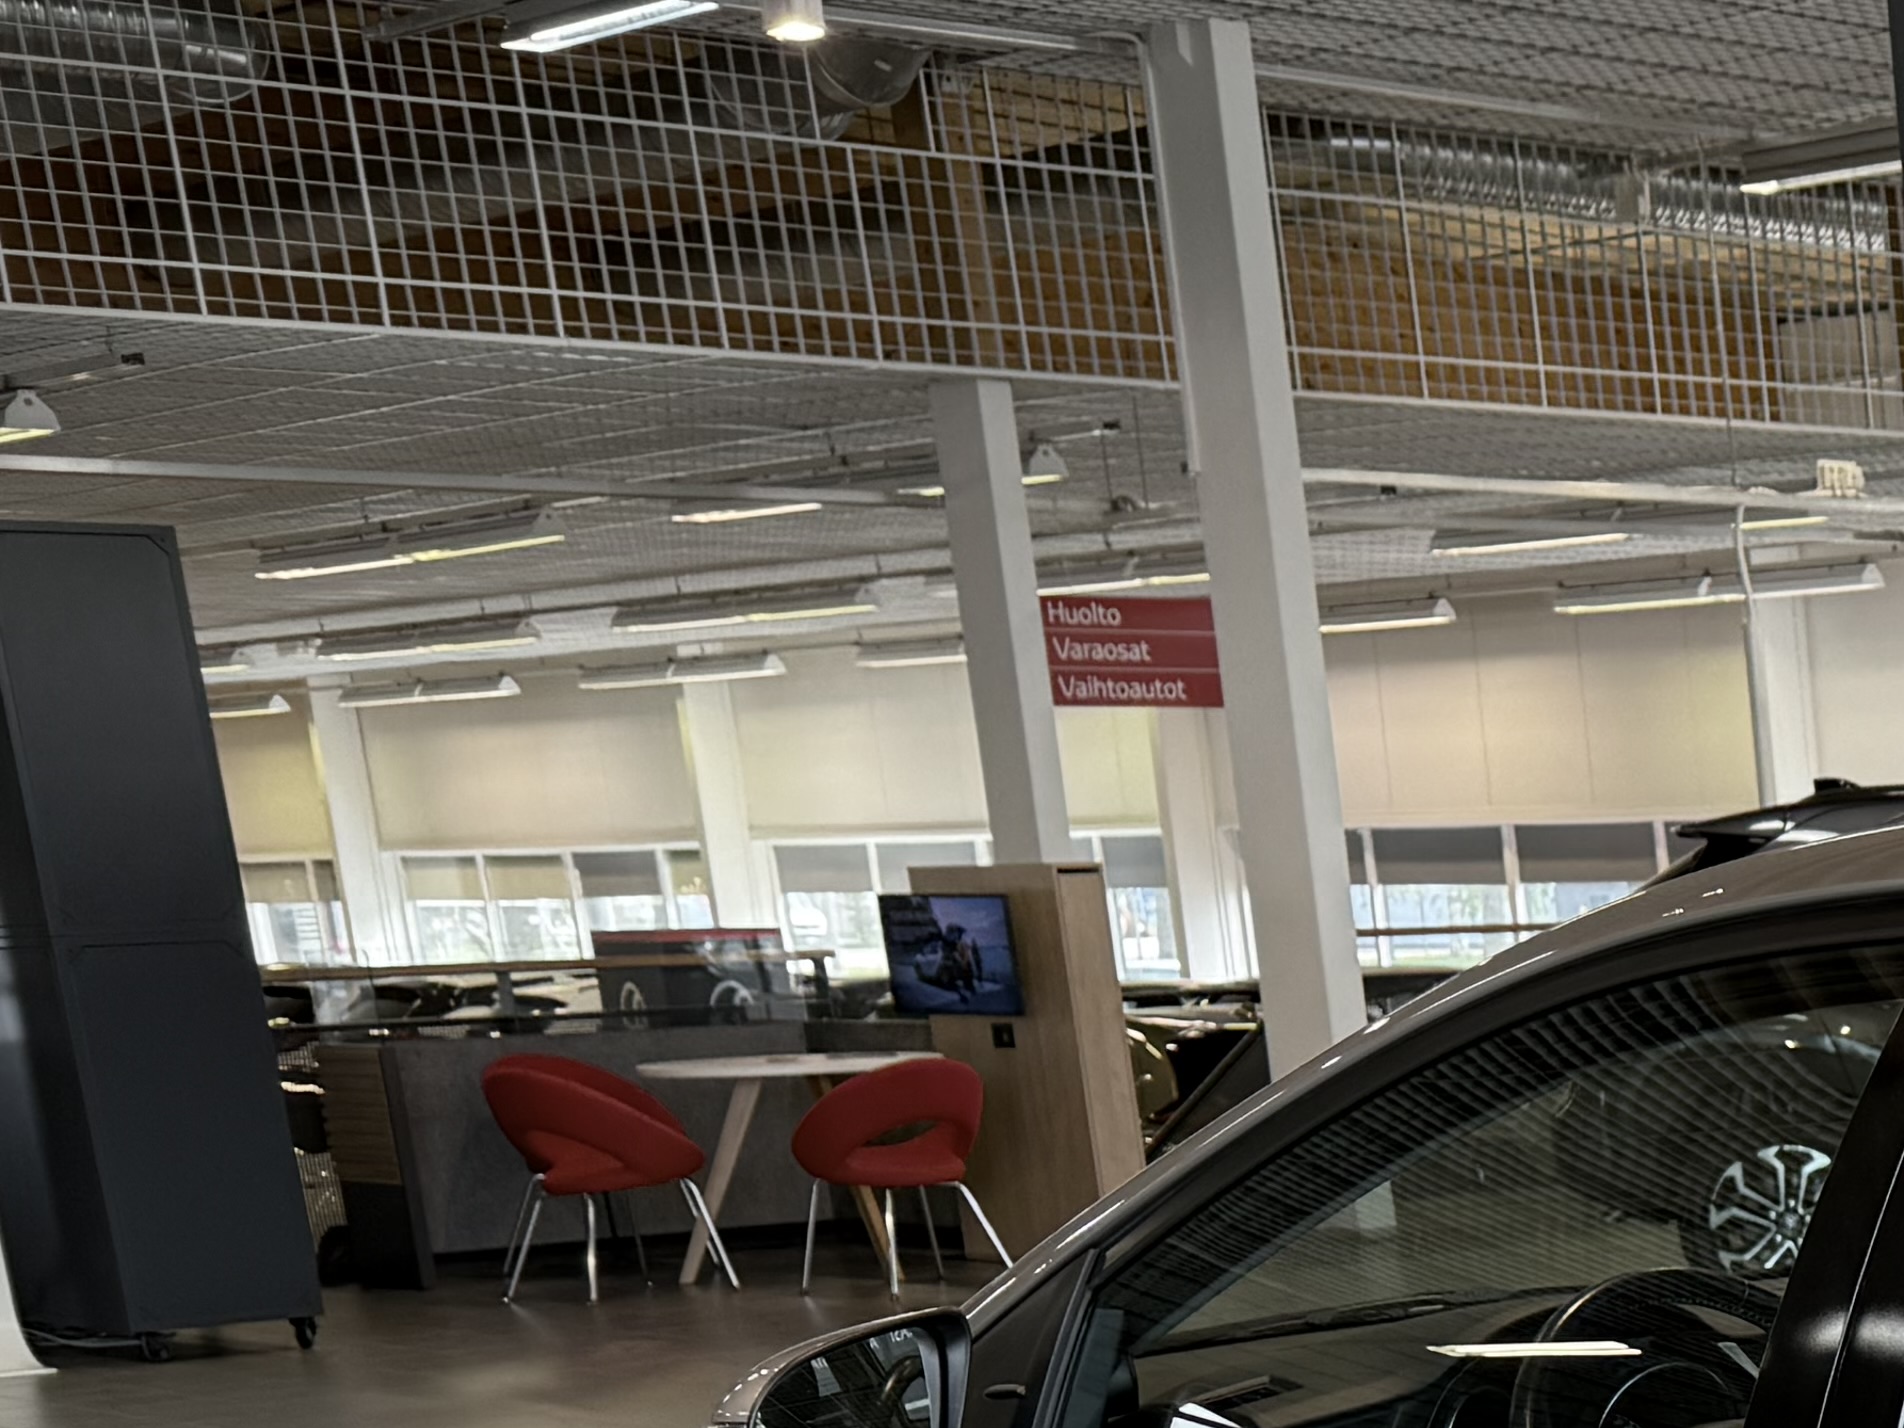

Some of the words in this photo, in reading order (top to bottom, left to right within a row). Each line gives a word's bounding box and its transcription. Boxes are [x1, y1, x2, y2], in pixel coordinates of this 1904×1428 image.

[1047, 601, 1121, 626] Huolto
[1052, 636, 1151, 662] Varaosat
[1057, 674, 1186, 699] Vaihtoautot
